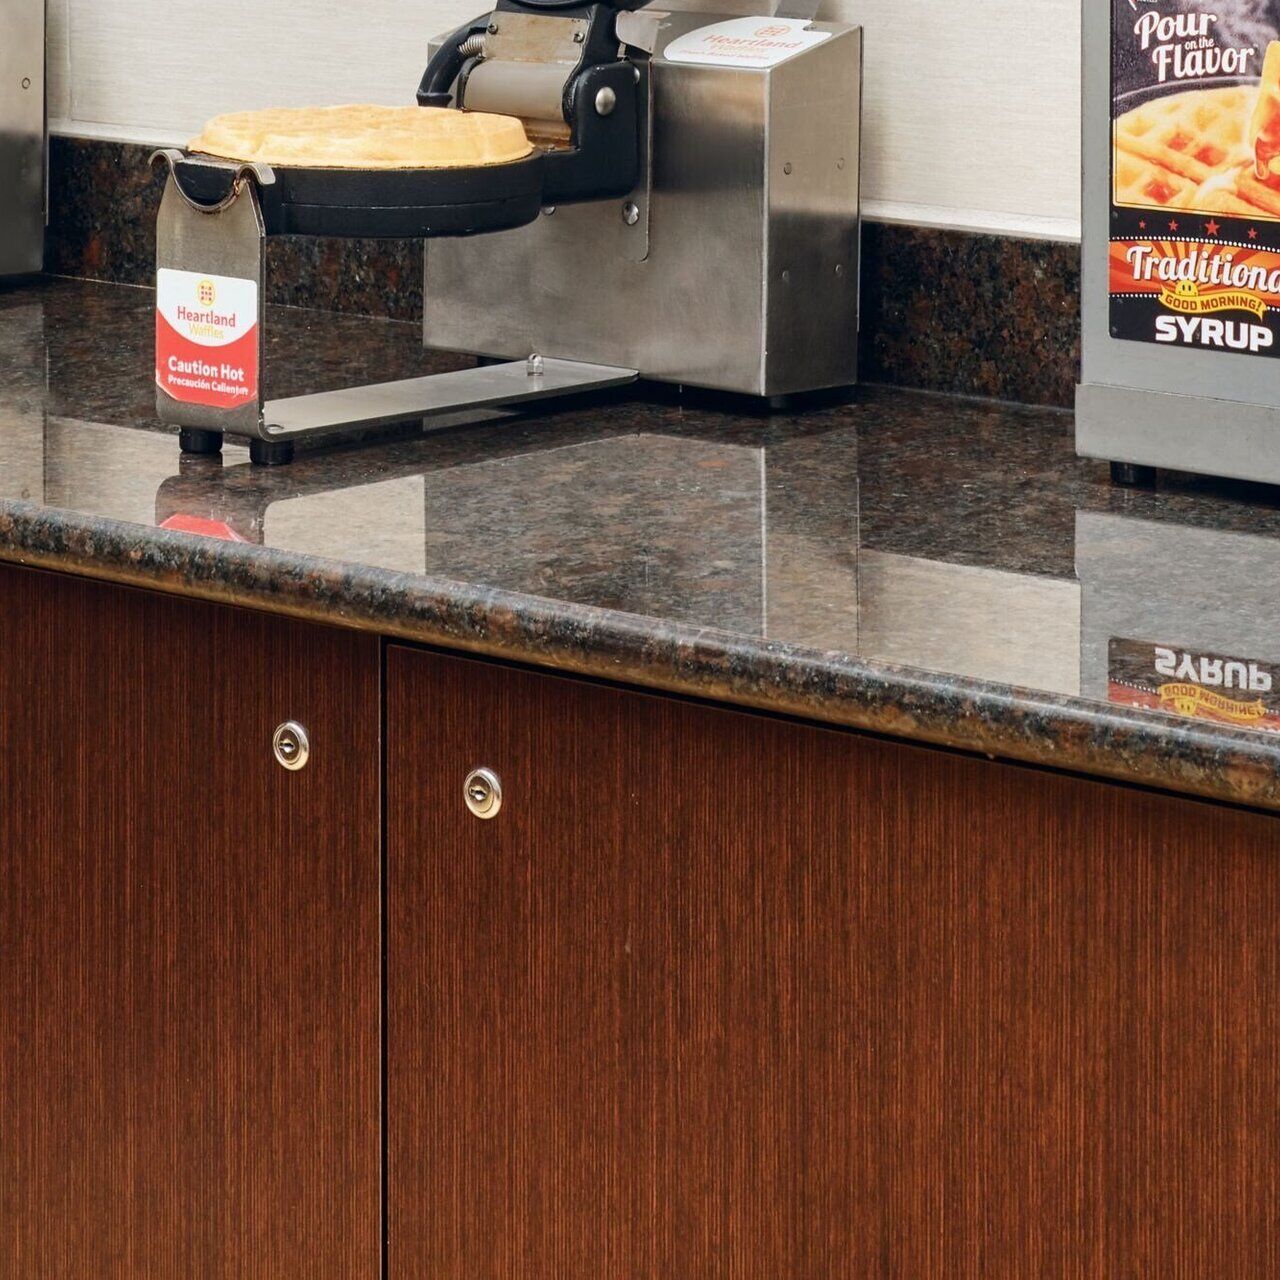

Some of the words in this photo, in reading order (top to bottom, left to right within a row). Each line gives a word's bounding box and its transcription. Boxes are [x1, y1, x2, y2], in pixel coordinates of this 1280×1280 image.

[1134, 11, 1217, 50] Pour
[1185, 41, 1198, 50] on
[1199, 37, 1214, 48] the
[1152, 44, 1255, 82] Flavor
[1165, 293, 1197, 311] GOOD
[1201, 296, 1262, 312] MORNING!
[177, 306, 236, 328] Heartland
[189, 324, 225, 340] Waffles
[1155, 315, 1273, 352] SYRUP
[168, 356, 218, 379] Caution
[221, 363, 244, 382] Hot
[168, 374, 210, 391] Precaución
